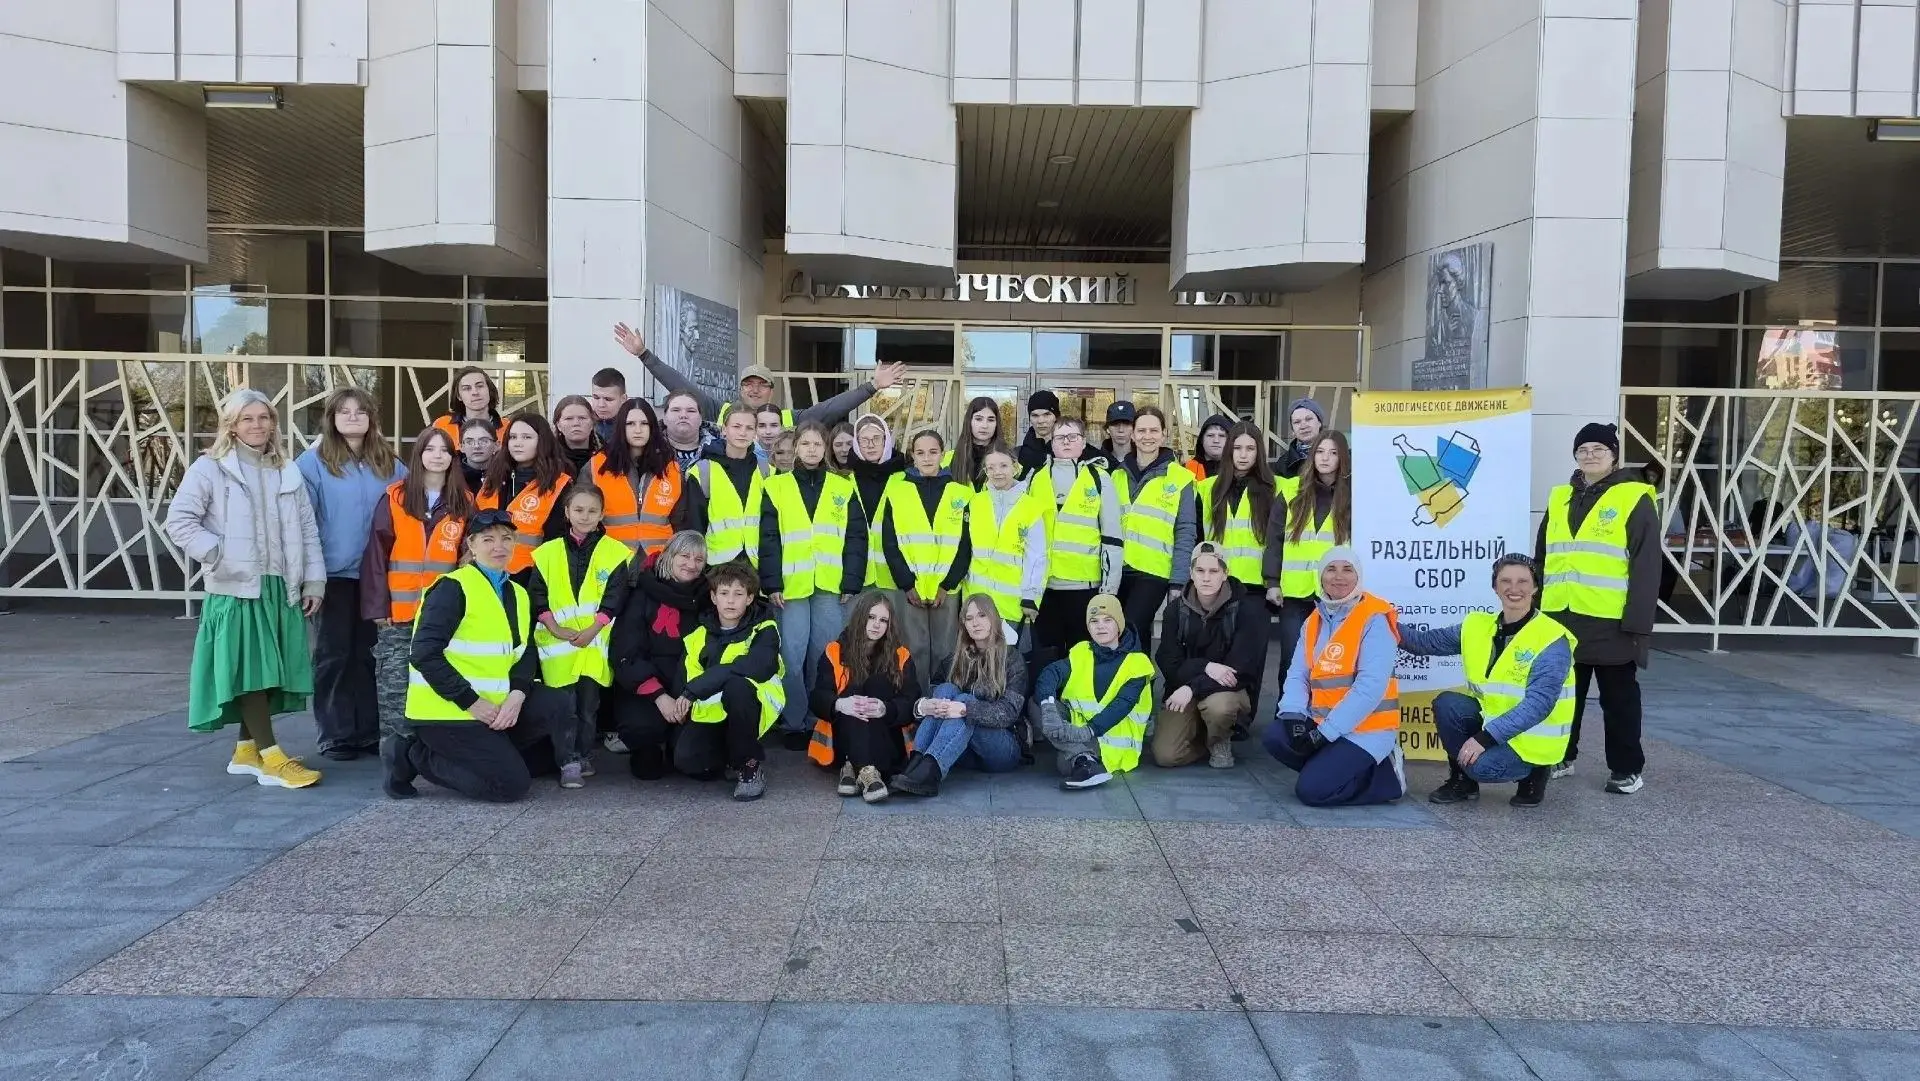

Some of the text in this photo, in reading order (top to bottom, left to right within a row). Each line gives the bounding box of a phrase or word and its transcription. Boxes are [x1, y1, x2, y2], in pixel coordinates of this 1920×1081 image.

[1374, 399, 1508, 413] ЭКОЛОГИЧЕСКОЕ ДВИЖЕНИЕ
[1371, 536, 1505, 561] РАЗДЕЛЬНЫЙ
[1415, 568, 1466, 588] СБОР
